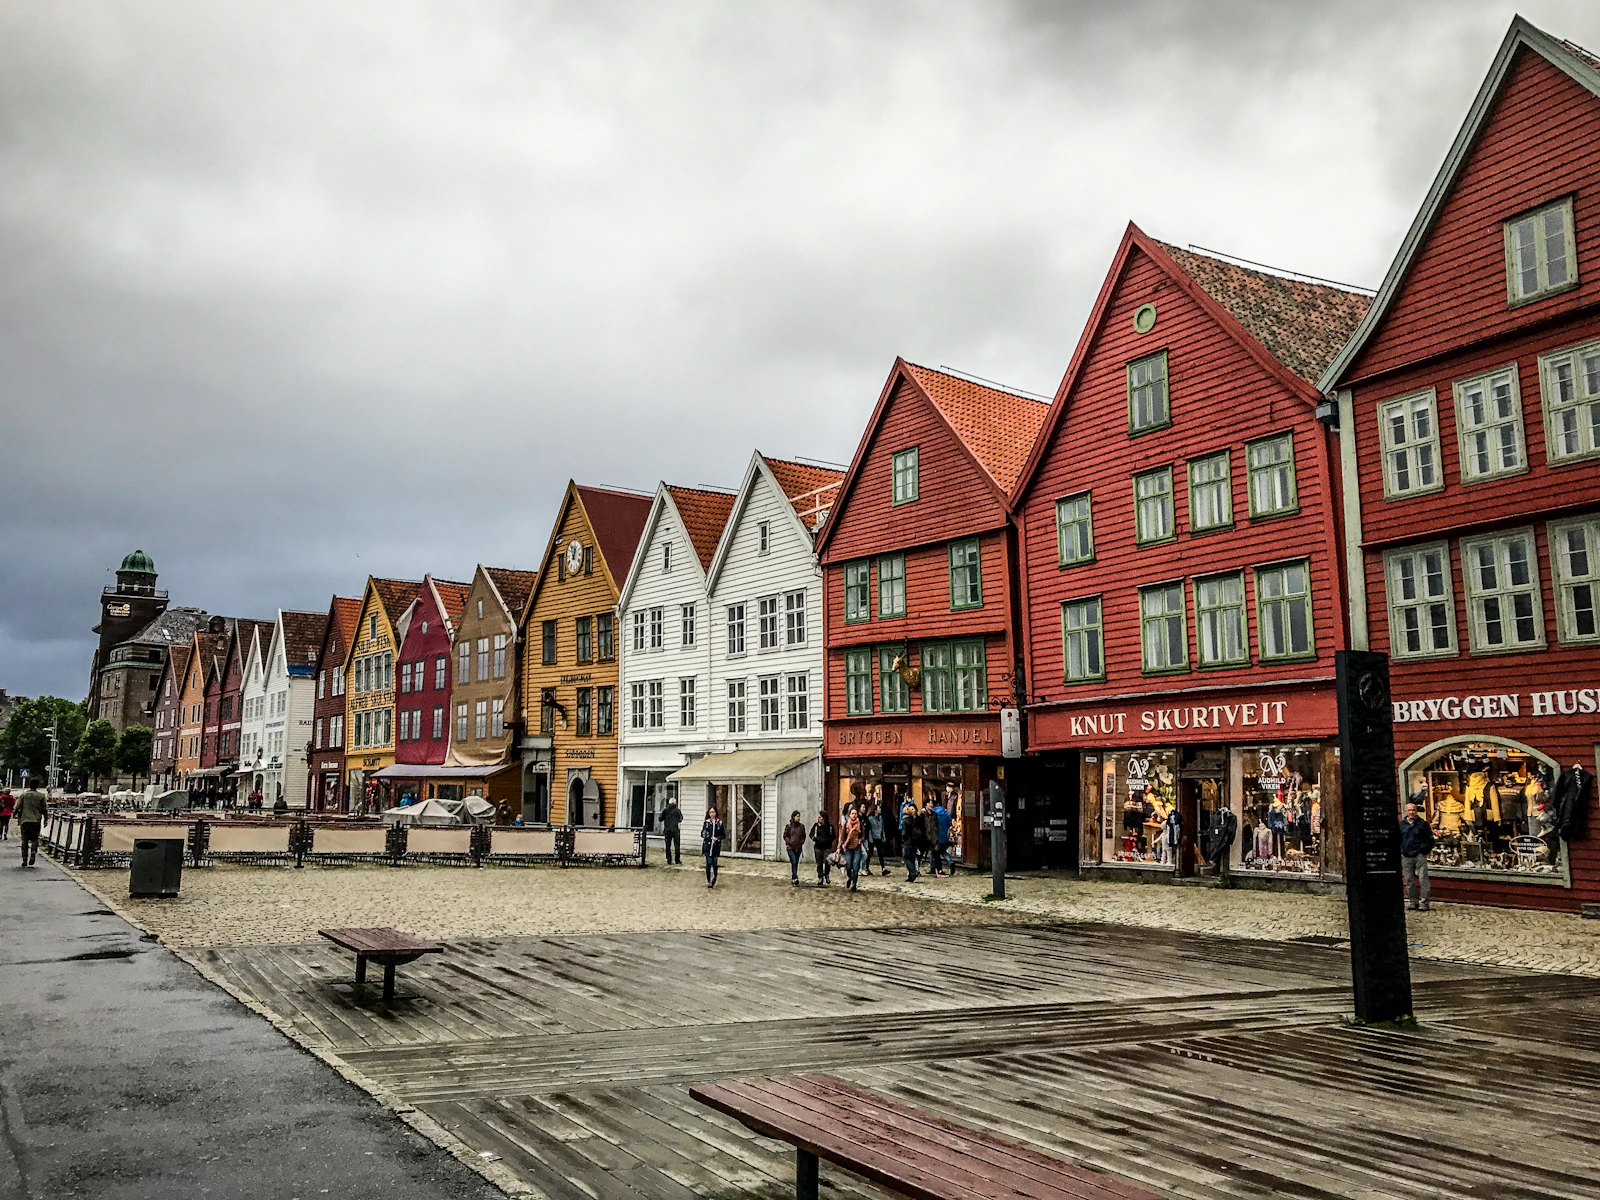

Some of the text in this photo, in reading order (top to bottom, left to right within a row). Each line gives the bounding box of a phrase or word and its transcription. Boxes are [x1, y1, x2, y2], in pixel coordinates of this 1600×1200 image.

[1070, 701, 1288, 736] KNUT SKURTVEIT
[1392, 688, 1600, 723] BRYGGEN HUS
[838, 729, 903, 747] BRYGGEN
[927, 728, 994, 745] HANDEL
